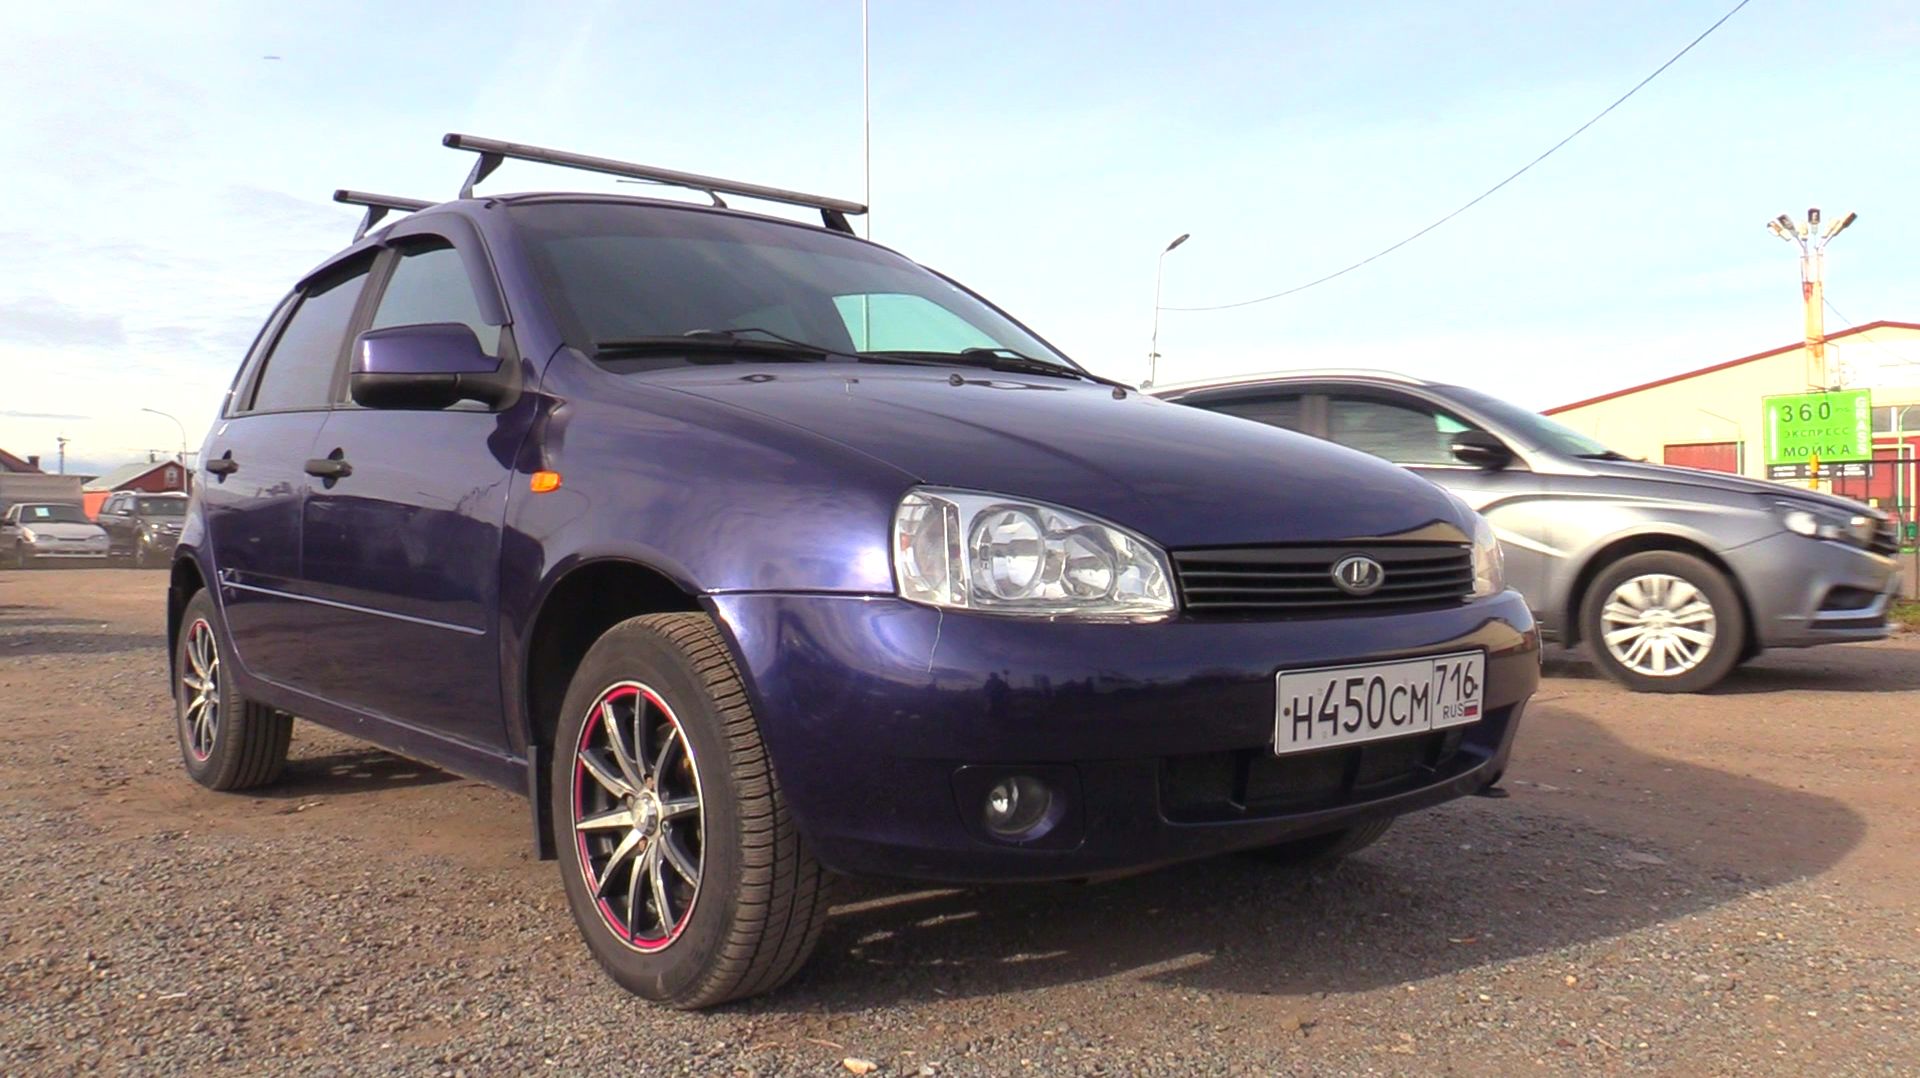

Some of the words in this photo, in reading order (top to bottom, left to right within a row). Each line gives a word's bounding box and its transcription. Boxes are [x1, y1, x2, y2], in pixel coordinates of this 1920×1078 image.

[1781, 402, 1831, 423] 360
[1784, 427, 1849, 438] ЭКСПРЕСС
[1783, 442, 1851, 457] МОЙКА
[1435, 661, 1475, 705] 716
[1442, 702, 1464, 719] RUS
